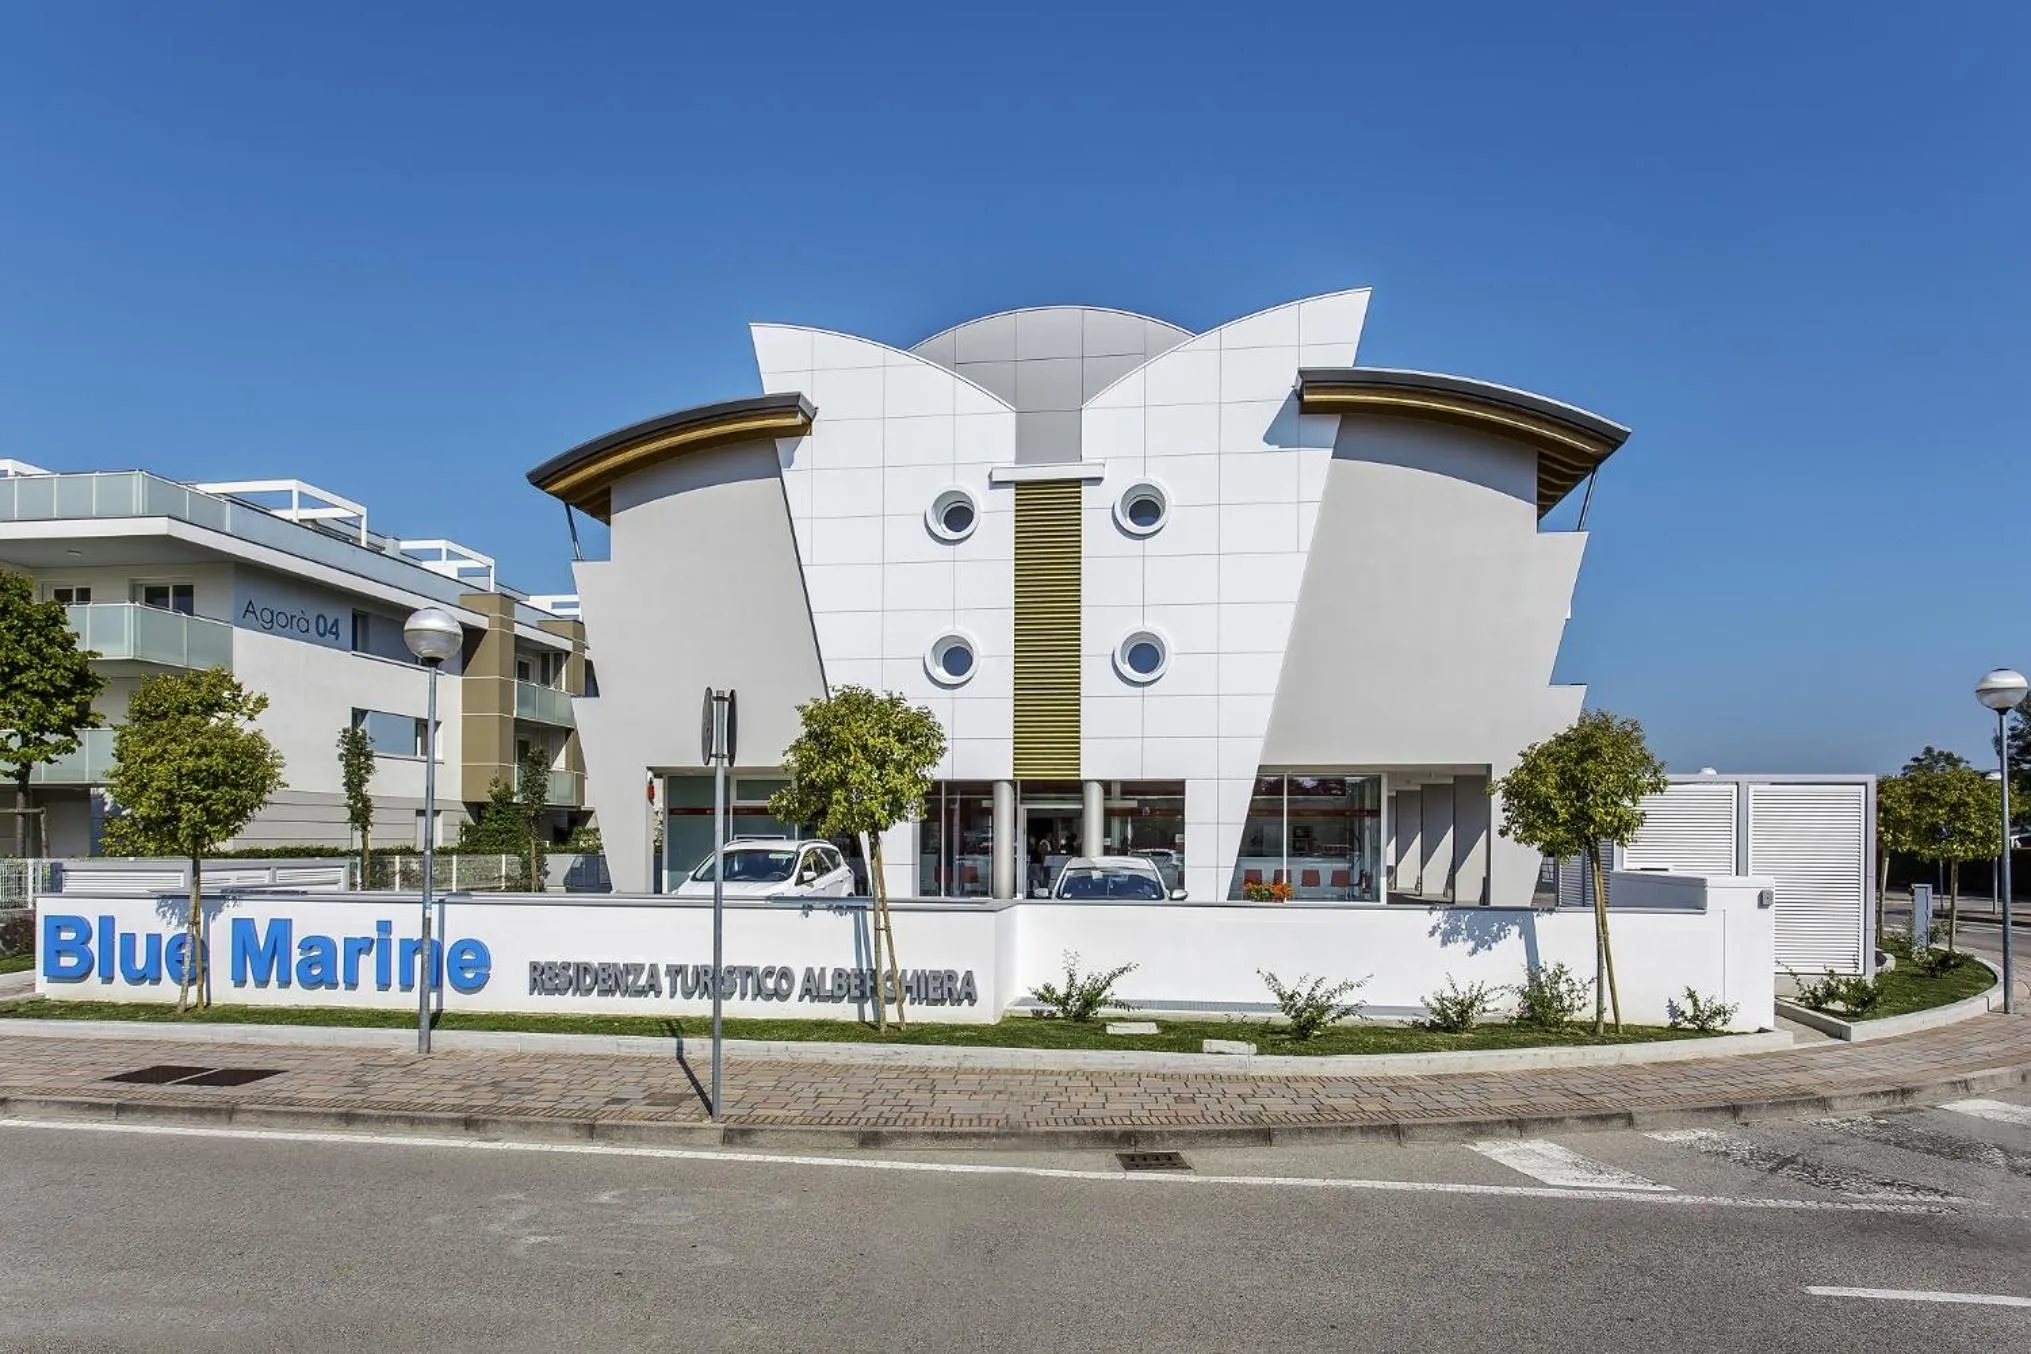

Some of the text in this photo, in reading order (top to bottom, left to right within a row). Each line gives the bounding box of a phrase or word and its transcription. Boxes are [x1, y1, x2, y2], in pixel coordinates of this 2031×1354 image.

[242, 599, 340, 641] Agorà 04
[43, 915, 492, 995] Blue Marine
[528, 961, 663, 998] RESIDENZA
[665, 963, 796, 1002] TURSTICO
